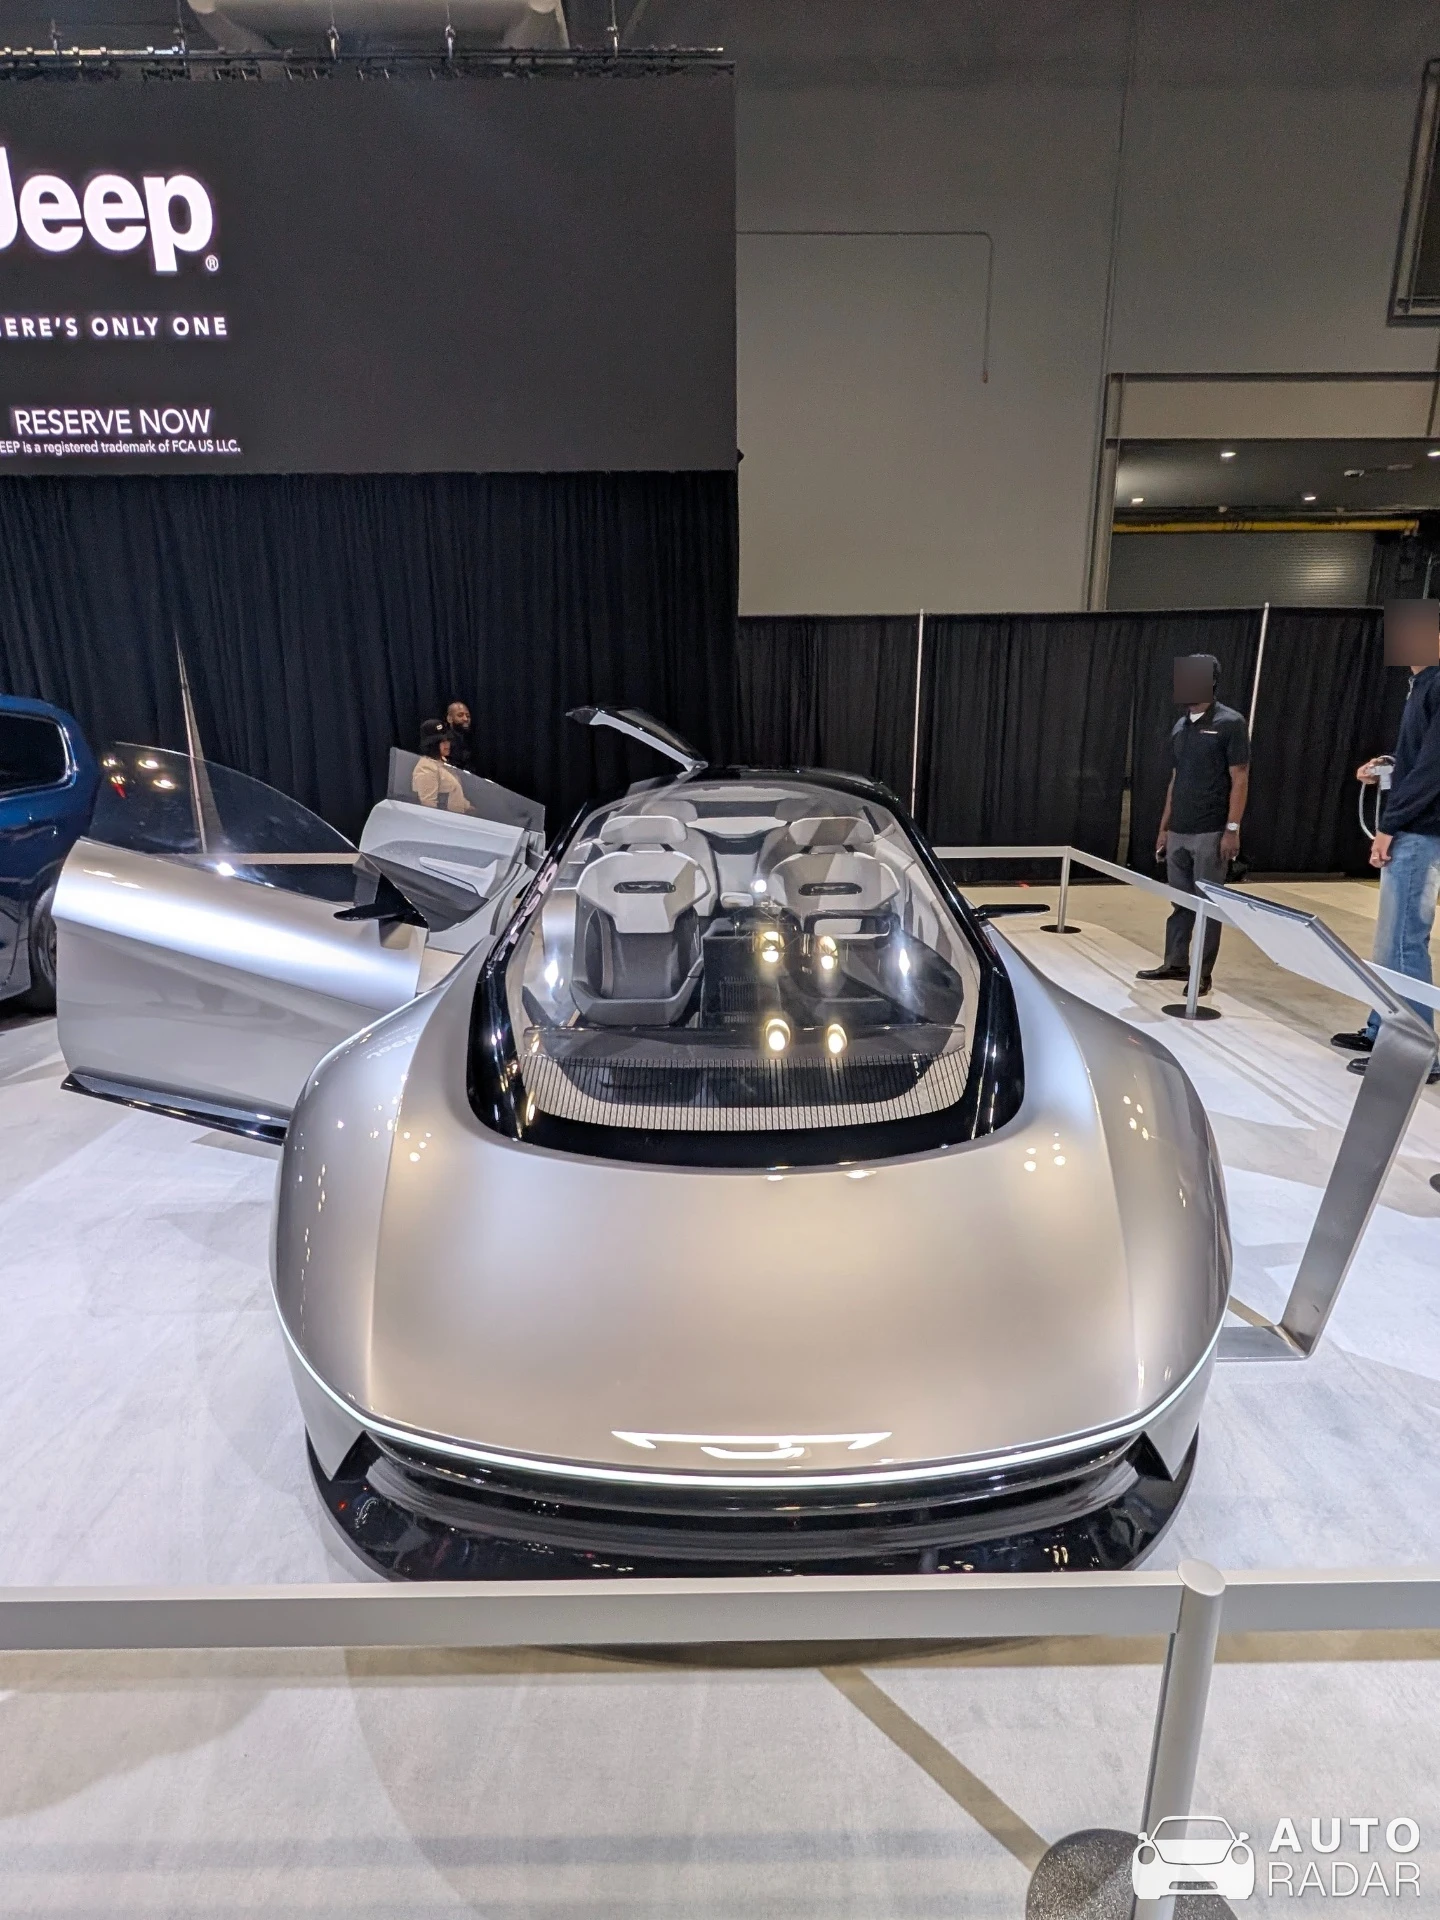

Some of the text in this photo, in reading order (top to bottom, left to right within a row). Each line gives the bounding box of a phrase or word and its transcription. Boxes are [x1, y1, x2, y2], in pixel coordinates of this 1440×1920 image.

[0, 316, 227, 337] ERE'S ONLY ONE
[14, 408, 211, 435] RESERVE NOW
[22, 440, 33, 453] is
[34, 443, 42, 453] a
[43, 440, 99, 456] registered
[100, 440, 156, 453] trademark
[158, 439, 170, 453] of
[171, 440, 197, 453] FCA
[198, 440, 214, 452] US
[216, 440, 241, 452] LLC.
